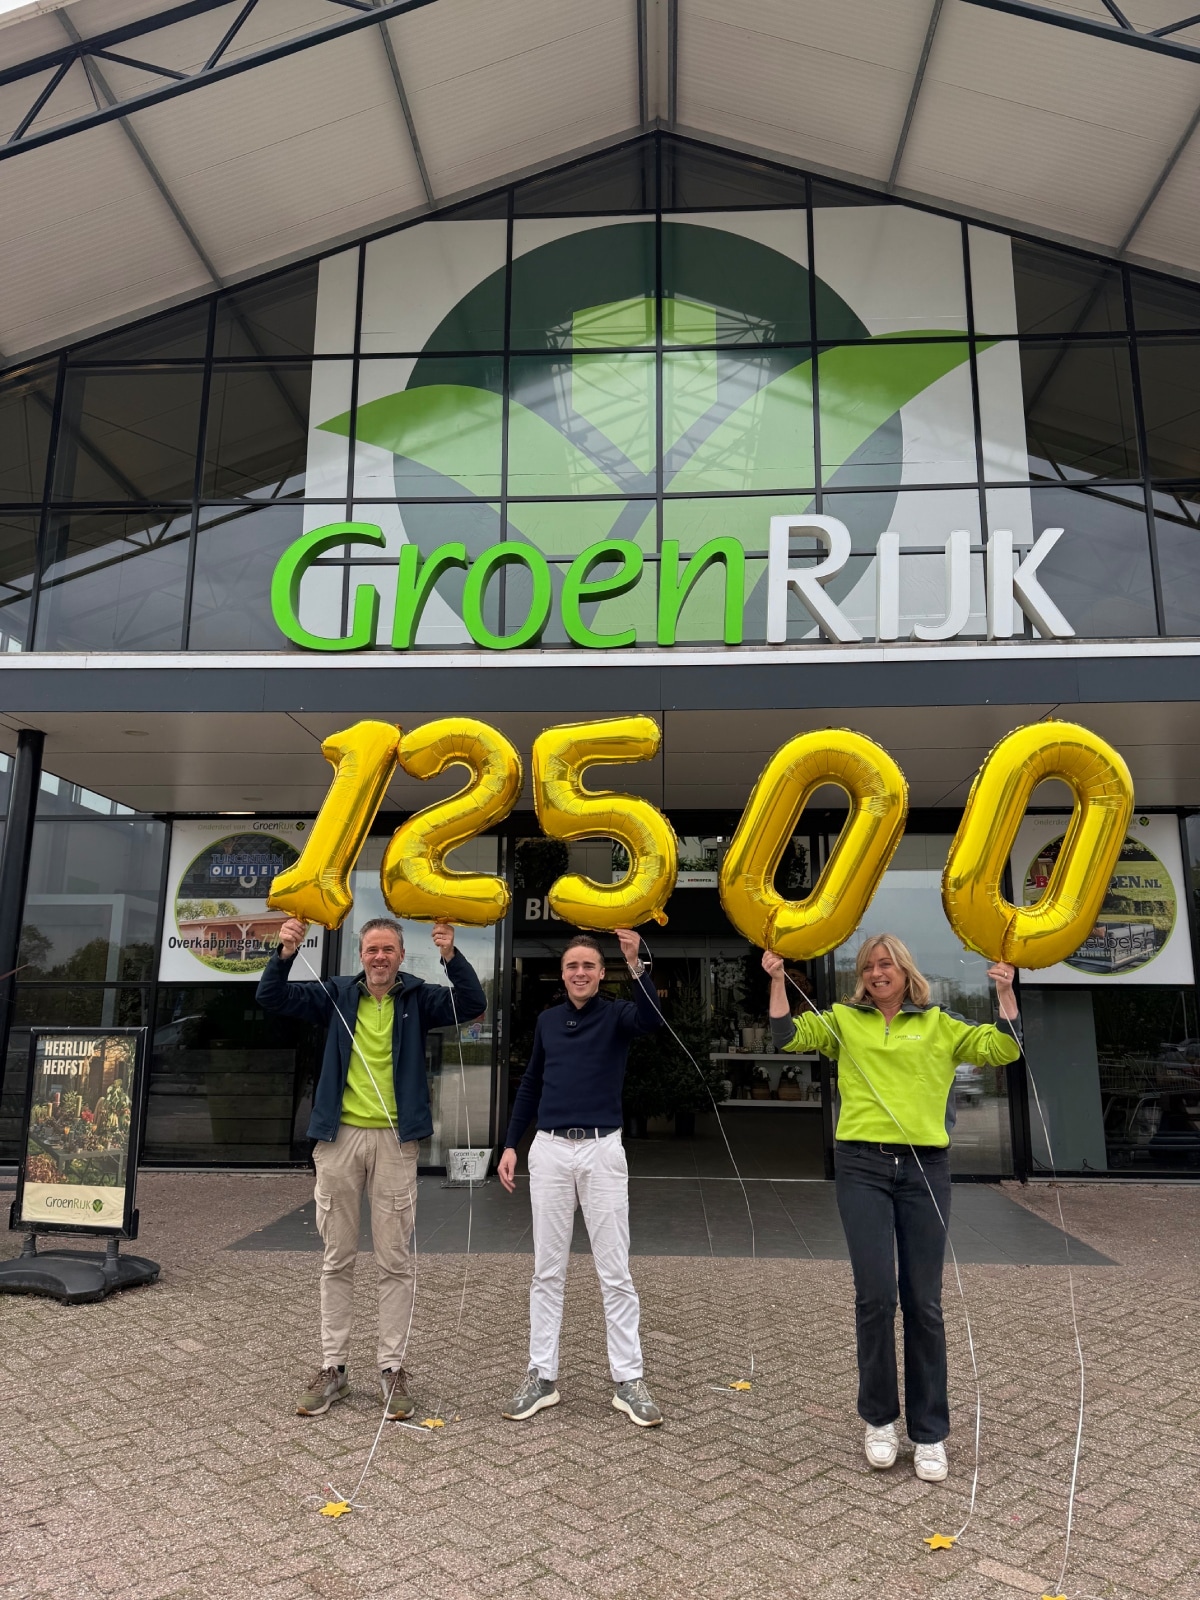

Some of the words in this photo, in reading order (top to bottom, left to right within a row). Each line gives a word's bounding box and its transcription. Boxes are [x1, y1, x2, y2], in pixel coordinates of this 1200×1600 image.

[212, 854, 284, 864] TUINCENTRUM
[212, 866, 280, 875] OUTLET
[44, 1041, 96, 1056] HEERLIJK
[43, 1060, 84, 1075] HERFST
